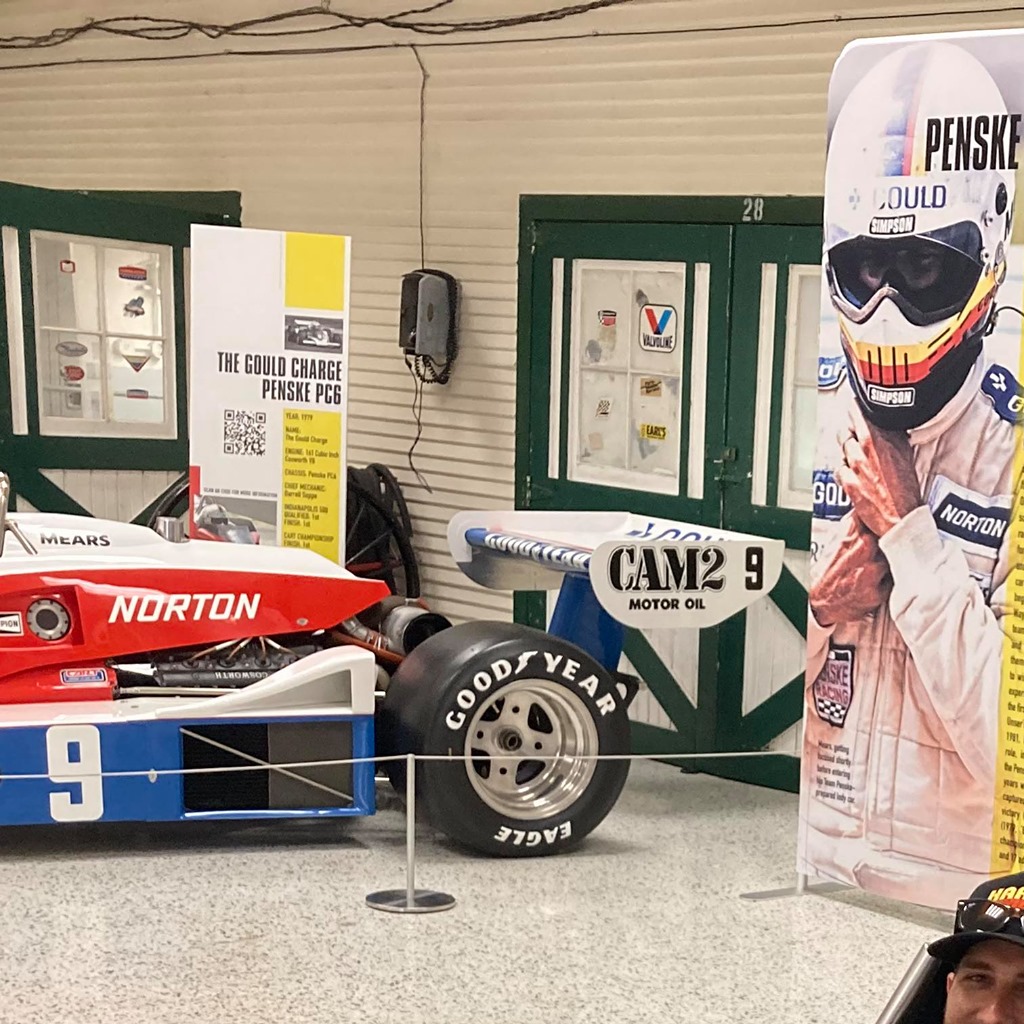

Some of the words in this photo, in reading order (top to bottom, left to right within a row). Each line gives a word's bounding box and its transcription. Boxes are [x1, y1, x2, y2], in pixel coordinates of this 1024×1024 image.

[925, 113, 1022, 172] PENSKE
[878, 185, 947, 210] OULD
[742, 197, 765, 222] 28
[870, 216, 914, 234] SIMPSON
[642, 333, 673, 349] VALVOLINE
[217, 351, 240, 373] THE
[245, 354, 286, 377] GOULD
[292, 357, 342, 382] CHARGE
[262, 379, 311, 403] PENSKE
[316, 383, 342, 405] PC6
[870, 389, 913, 404] SIMPSON
[285, 434, 294, 442] The
[295, 435, 309, 443] Gould
[310, 436, 328, 445] Charge
[939, 503, 1007, 538] NORTON
[41, 532, 111, 547] MEARS
[609, 547, 724, 591] CAM2
[744, 546, 765, 591] 9
[108, 592, 261, 624] NORTON
[628, 597, 680, 610] MOTOR
[684, 597, 706, 610] OIL
[1011, 639, 1021, 649] and
[215, 671, 269, 680] COSWORTH
[1009, 670, 1014, 680] to
[1004, 747, 1017, 759] role,
[45, 725, 104, 822] 9
[1003, 779, 1018, 791] years
[494, 820, 573, 847] EAGLE
